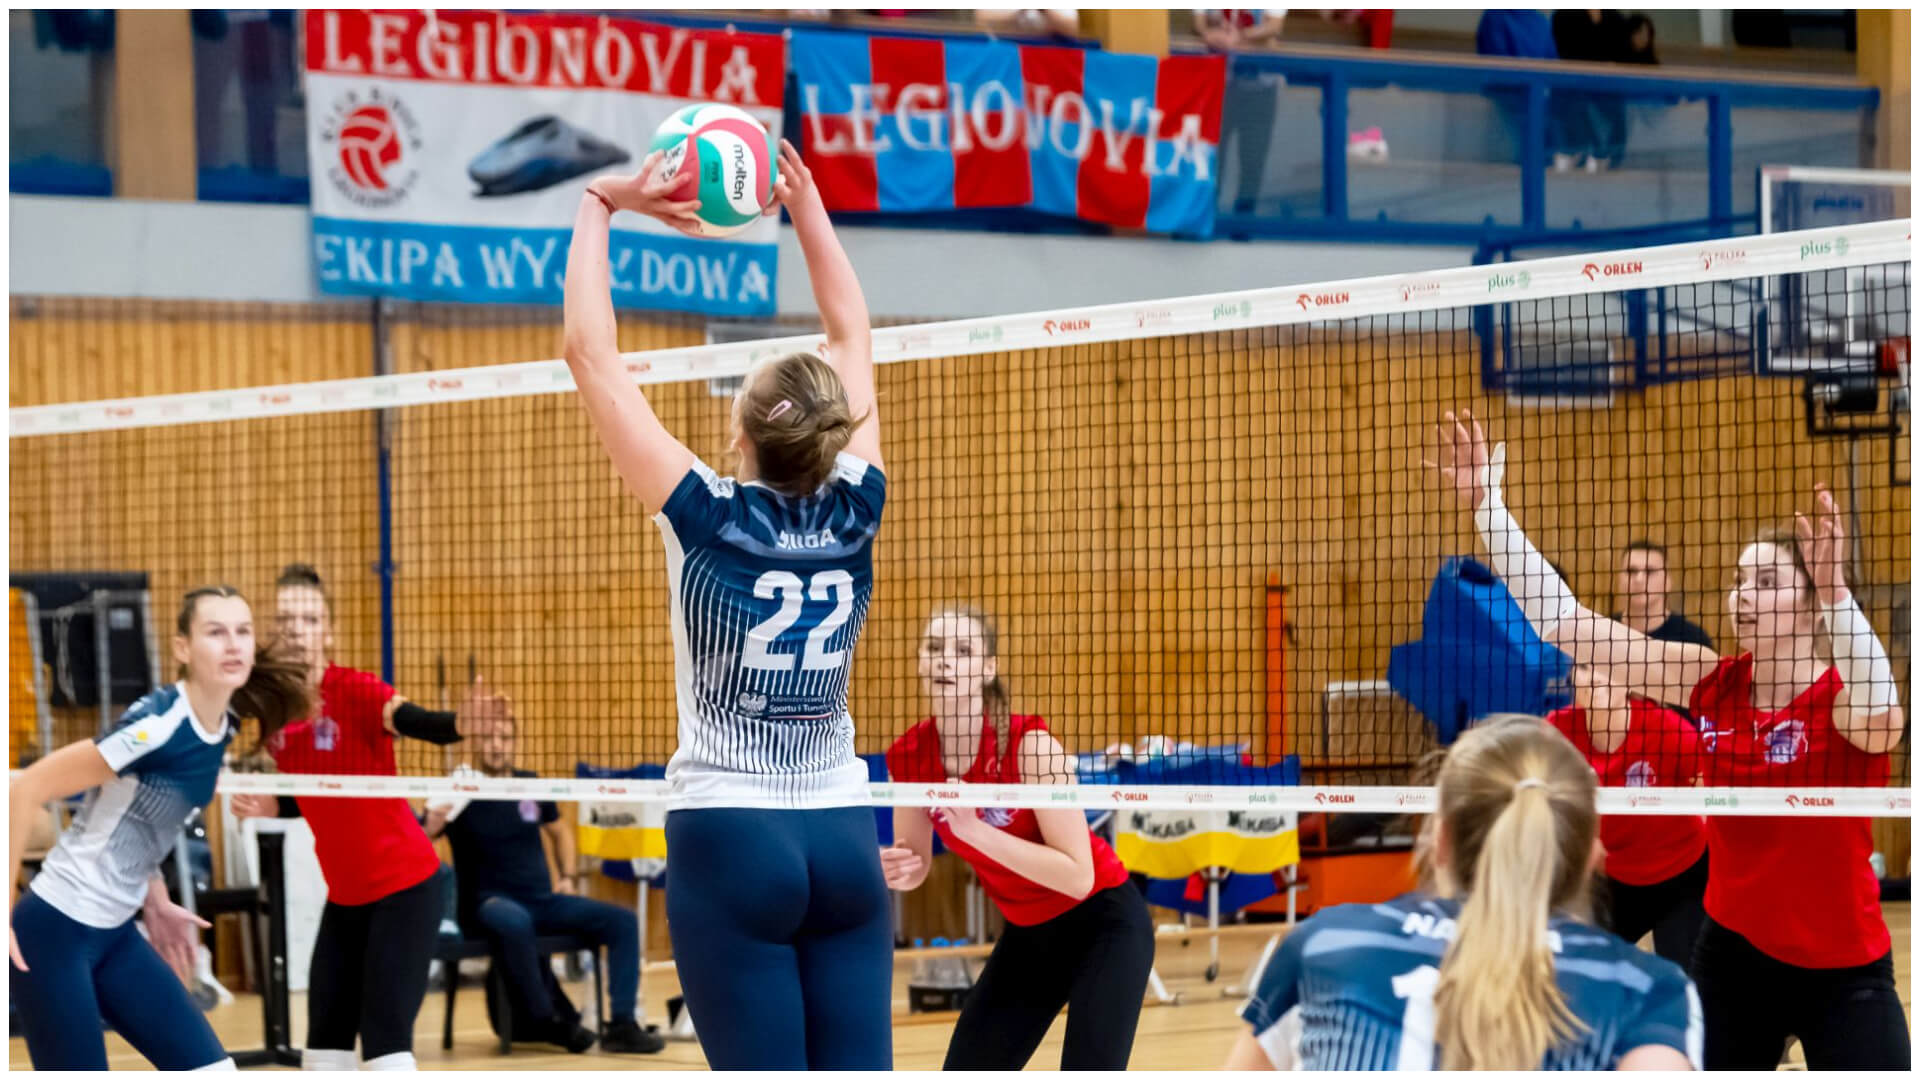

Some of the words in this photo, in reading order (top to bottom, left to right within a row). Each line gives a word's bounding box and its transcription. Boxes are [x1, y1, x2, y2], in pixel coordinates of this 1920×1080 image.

[323, 11, 760, 102] LEGIONOVIA
[805, 80, 1210, 180] LEGIONOVIA
[733, 144, 747, 200] molten
[315, 234, 464, 288] EKIPA
[1059, 319, 1091, 333] ORLEN
[1213, 305, 1237, 321] plus
[1315, 291, 1350, 306] ORLEN
[1488, 274, 1515, 293] plus
[1603, 261, 1642, 277] ORLEN
[1800, 239, 1832, 261] plus
[742, 569, 855, 671] 22
[769, 704, 797, 713] Sportu
[1328, 793, 1356, 804] ORLEN
[1704, 795, 1727, 808] plus
[1802, 796, 1835, 807] ORLEN
